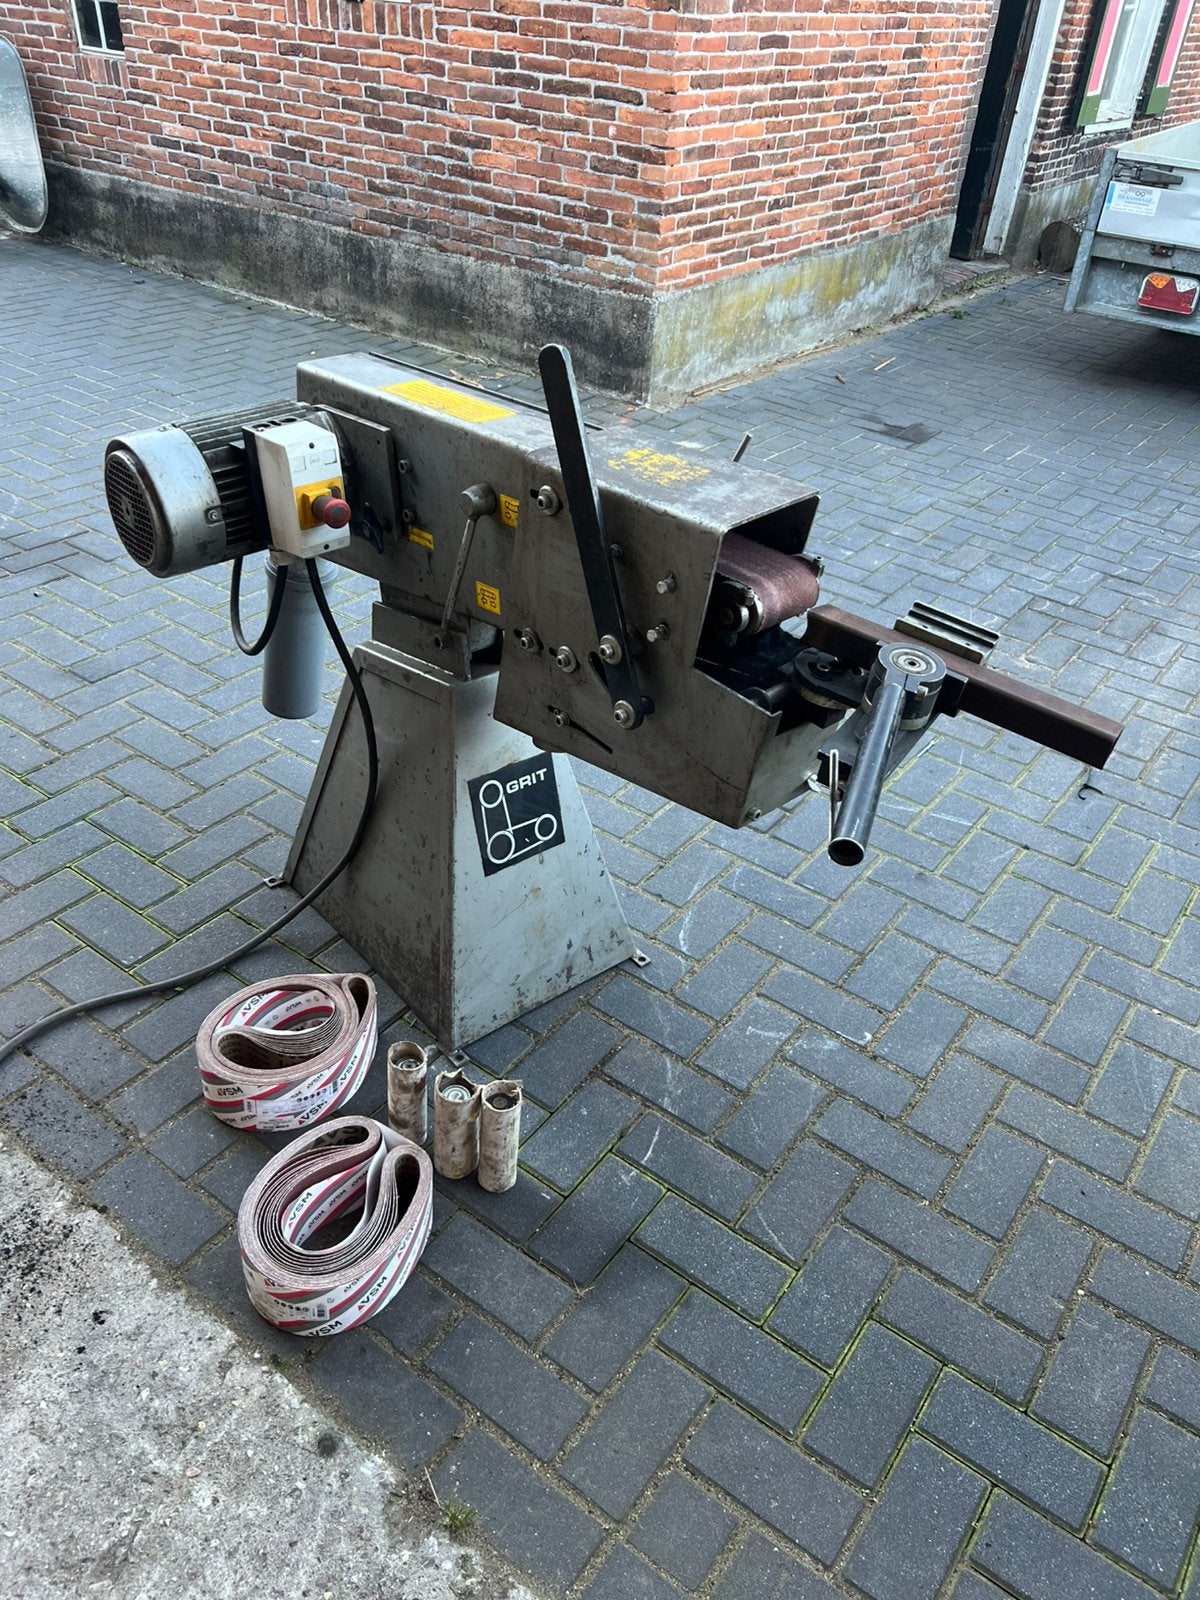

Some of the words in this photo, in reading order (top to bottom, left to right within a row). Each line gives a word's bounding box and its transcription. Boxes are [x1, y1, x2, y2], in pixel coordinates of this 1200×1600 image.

[506, 768, 547, 794] GRIT
[288, 1001, 303, 1010] VSM
[340, 1055, 358, 1080] VSM
[310, 1073, 324, 1086] VSM
[220, 1086, 244, 1096] VSM
[332, 1189, 348, 1204] VSM
[289, 1192, 313, 1221] VSM
[311, 1210, 325, 1224] VSM
[361, 1276, 388, 1305] VSM
[310, 1320, 342, 1337] VSM
